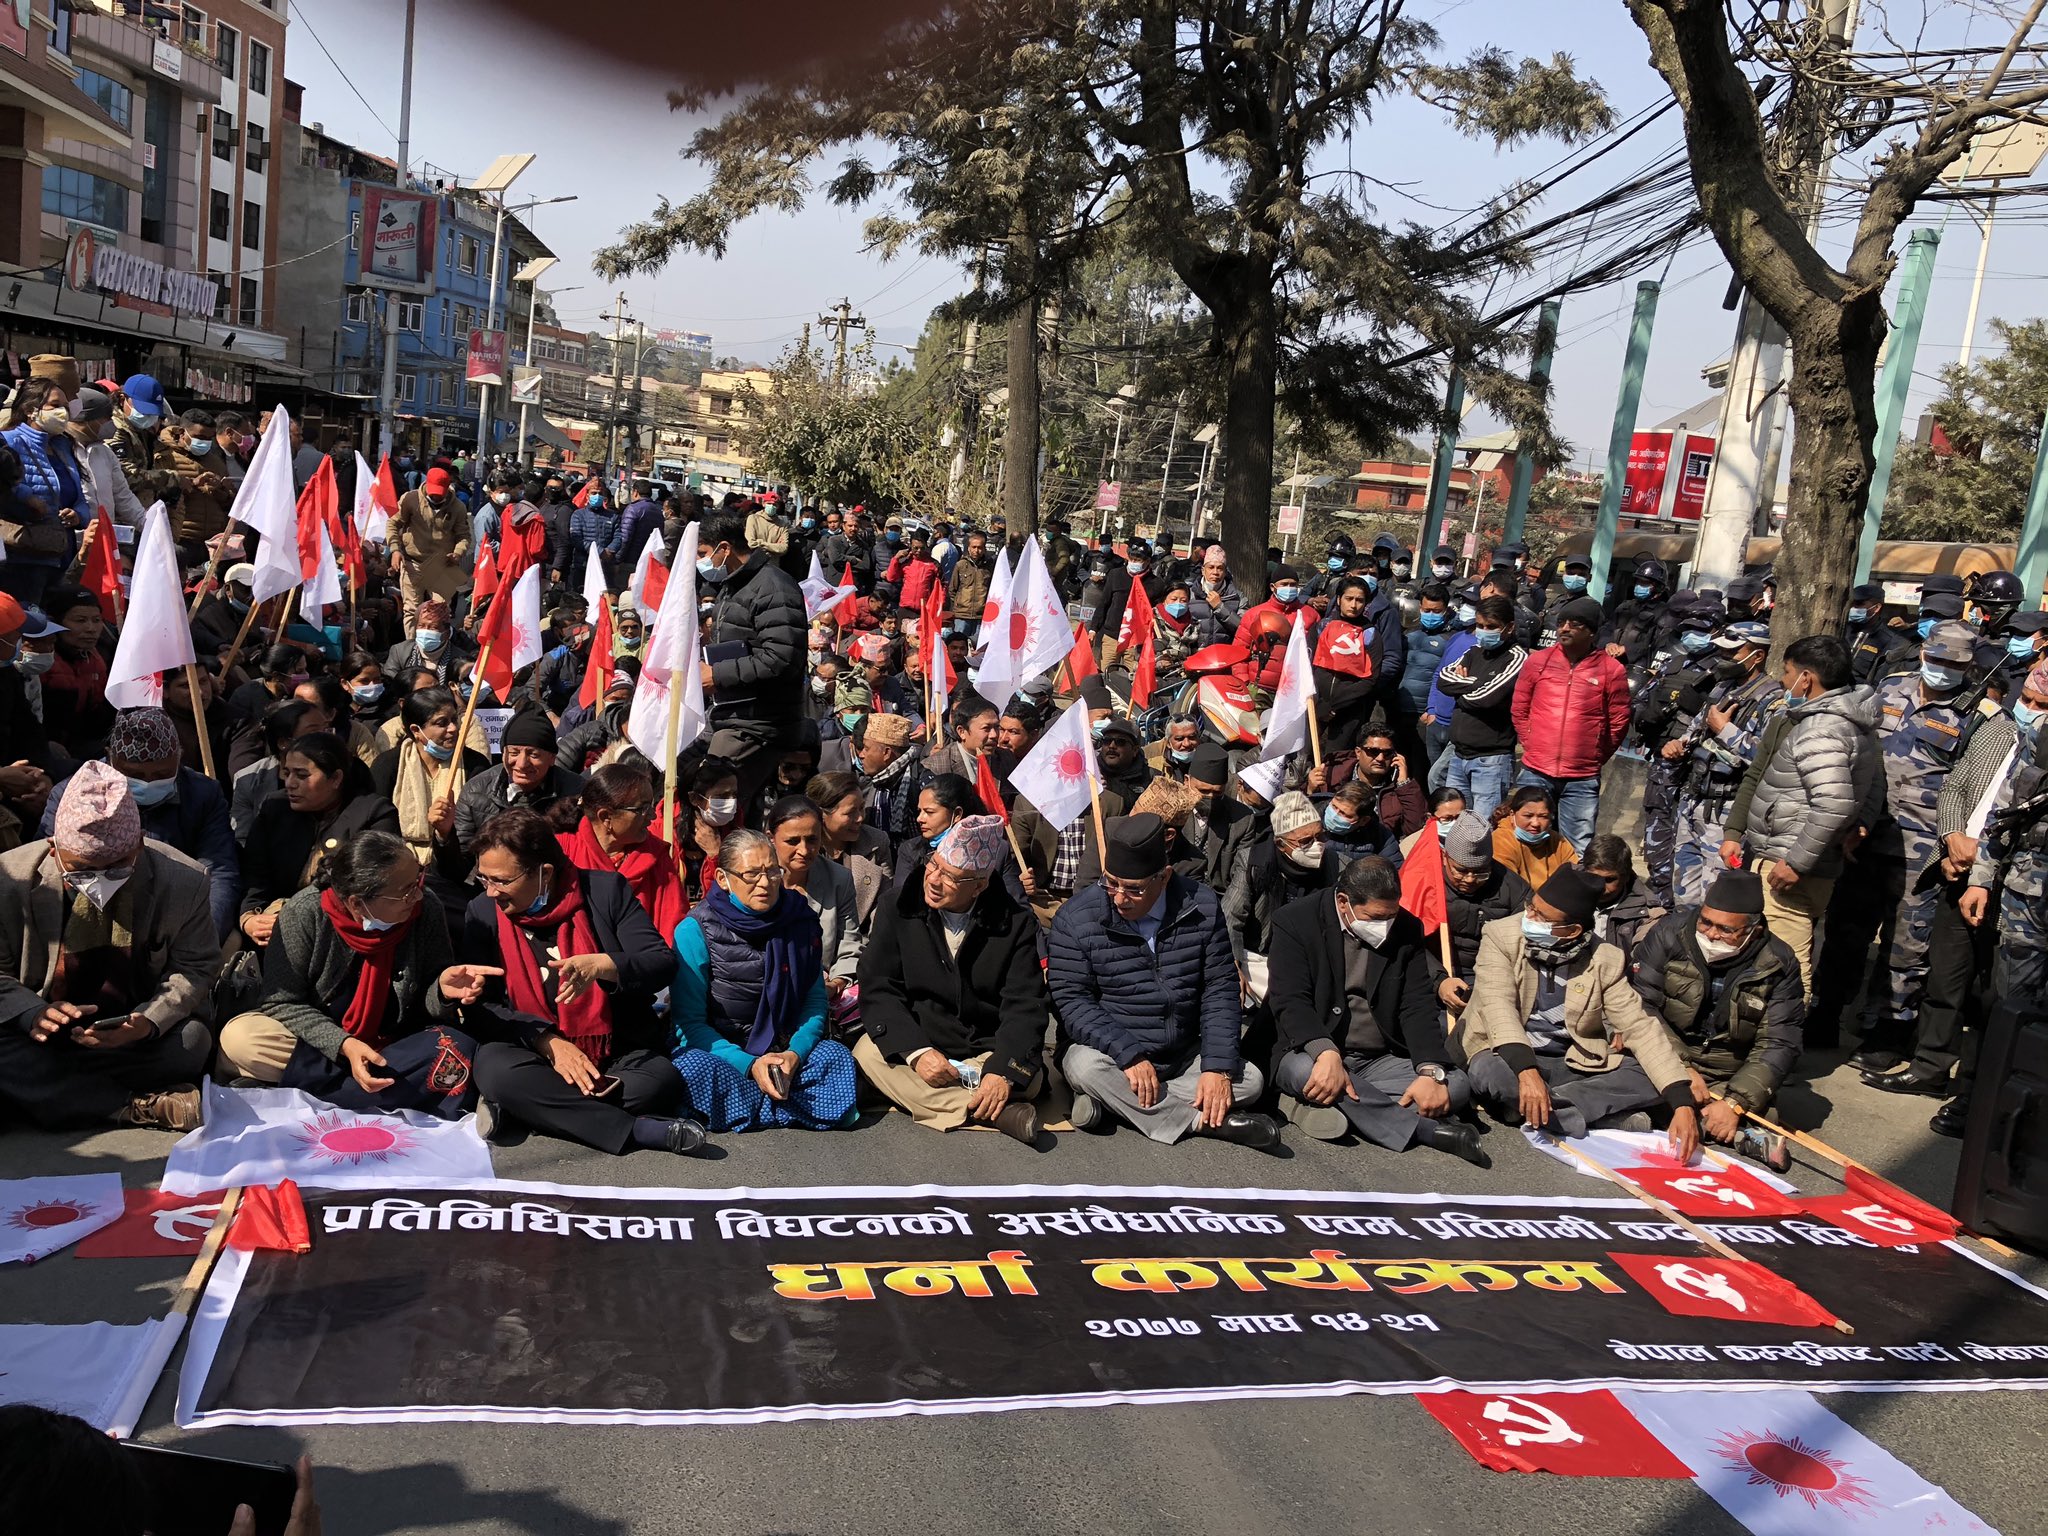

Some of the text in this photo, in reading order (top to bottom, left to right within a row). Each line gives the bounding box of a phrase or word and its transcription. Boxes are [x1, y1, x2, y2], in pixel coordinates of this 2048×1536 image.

[95, 245, 219, 318] CHICKEN STATION
[322, 1199, 695, 1241] प्रतिनिधिसभा
[715, 1207, 974, 1240] विघटनको
[988, 1204, 1286, 1236] असंवैधानिक
[1411, 1211, 1613, 1240] प्रतिगामी
[1081, 1249, 1627, 1294] कार्यक्रम
[1084, 1318, 1201, 1338] २०७७
[1211, 1313, 1303, 1334] माघ
[1606, 1339, 1719, 1361] नेपाल
